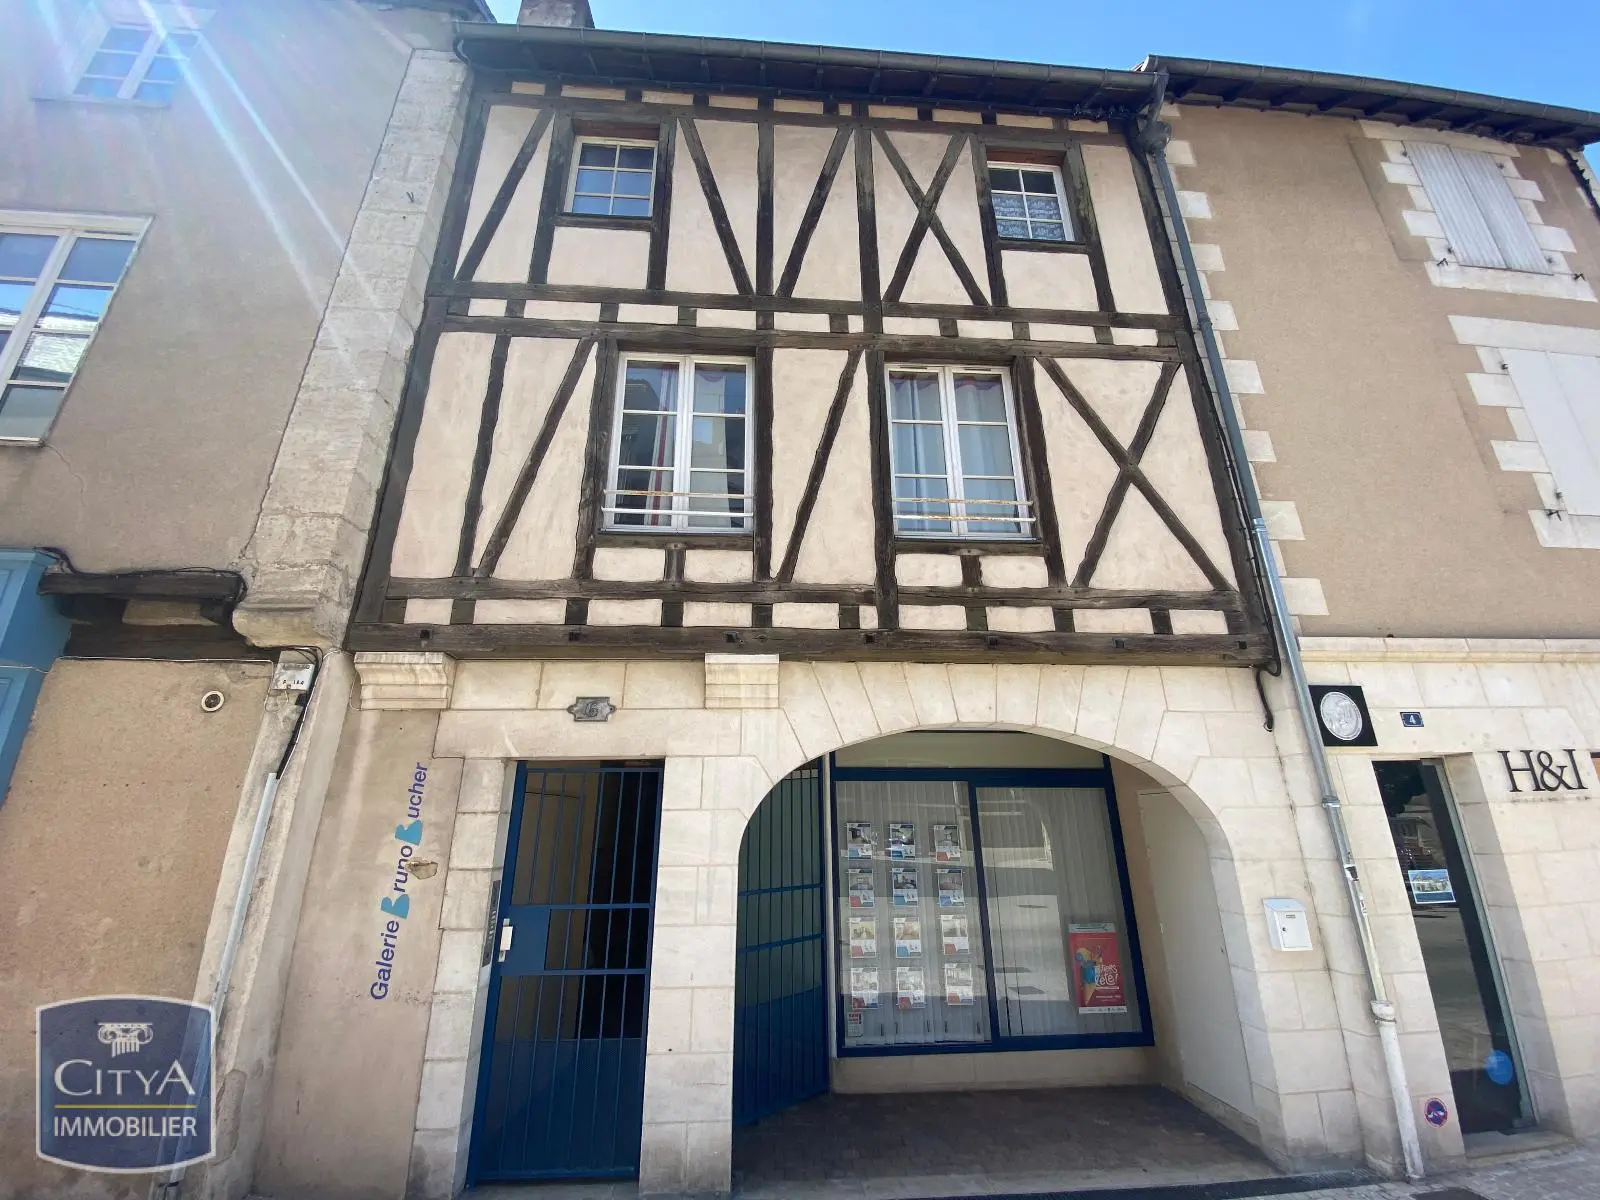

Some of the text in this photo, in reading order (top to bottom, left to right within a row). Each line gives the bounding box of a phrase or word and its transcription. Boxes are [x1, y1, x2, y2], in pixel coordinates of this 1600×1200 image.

[1408, 714, 1417, 725] 4
[1497, 748, 1588, 792] H&I
[370, 762, 428, 1000] Galerie Bruno Bucher
